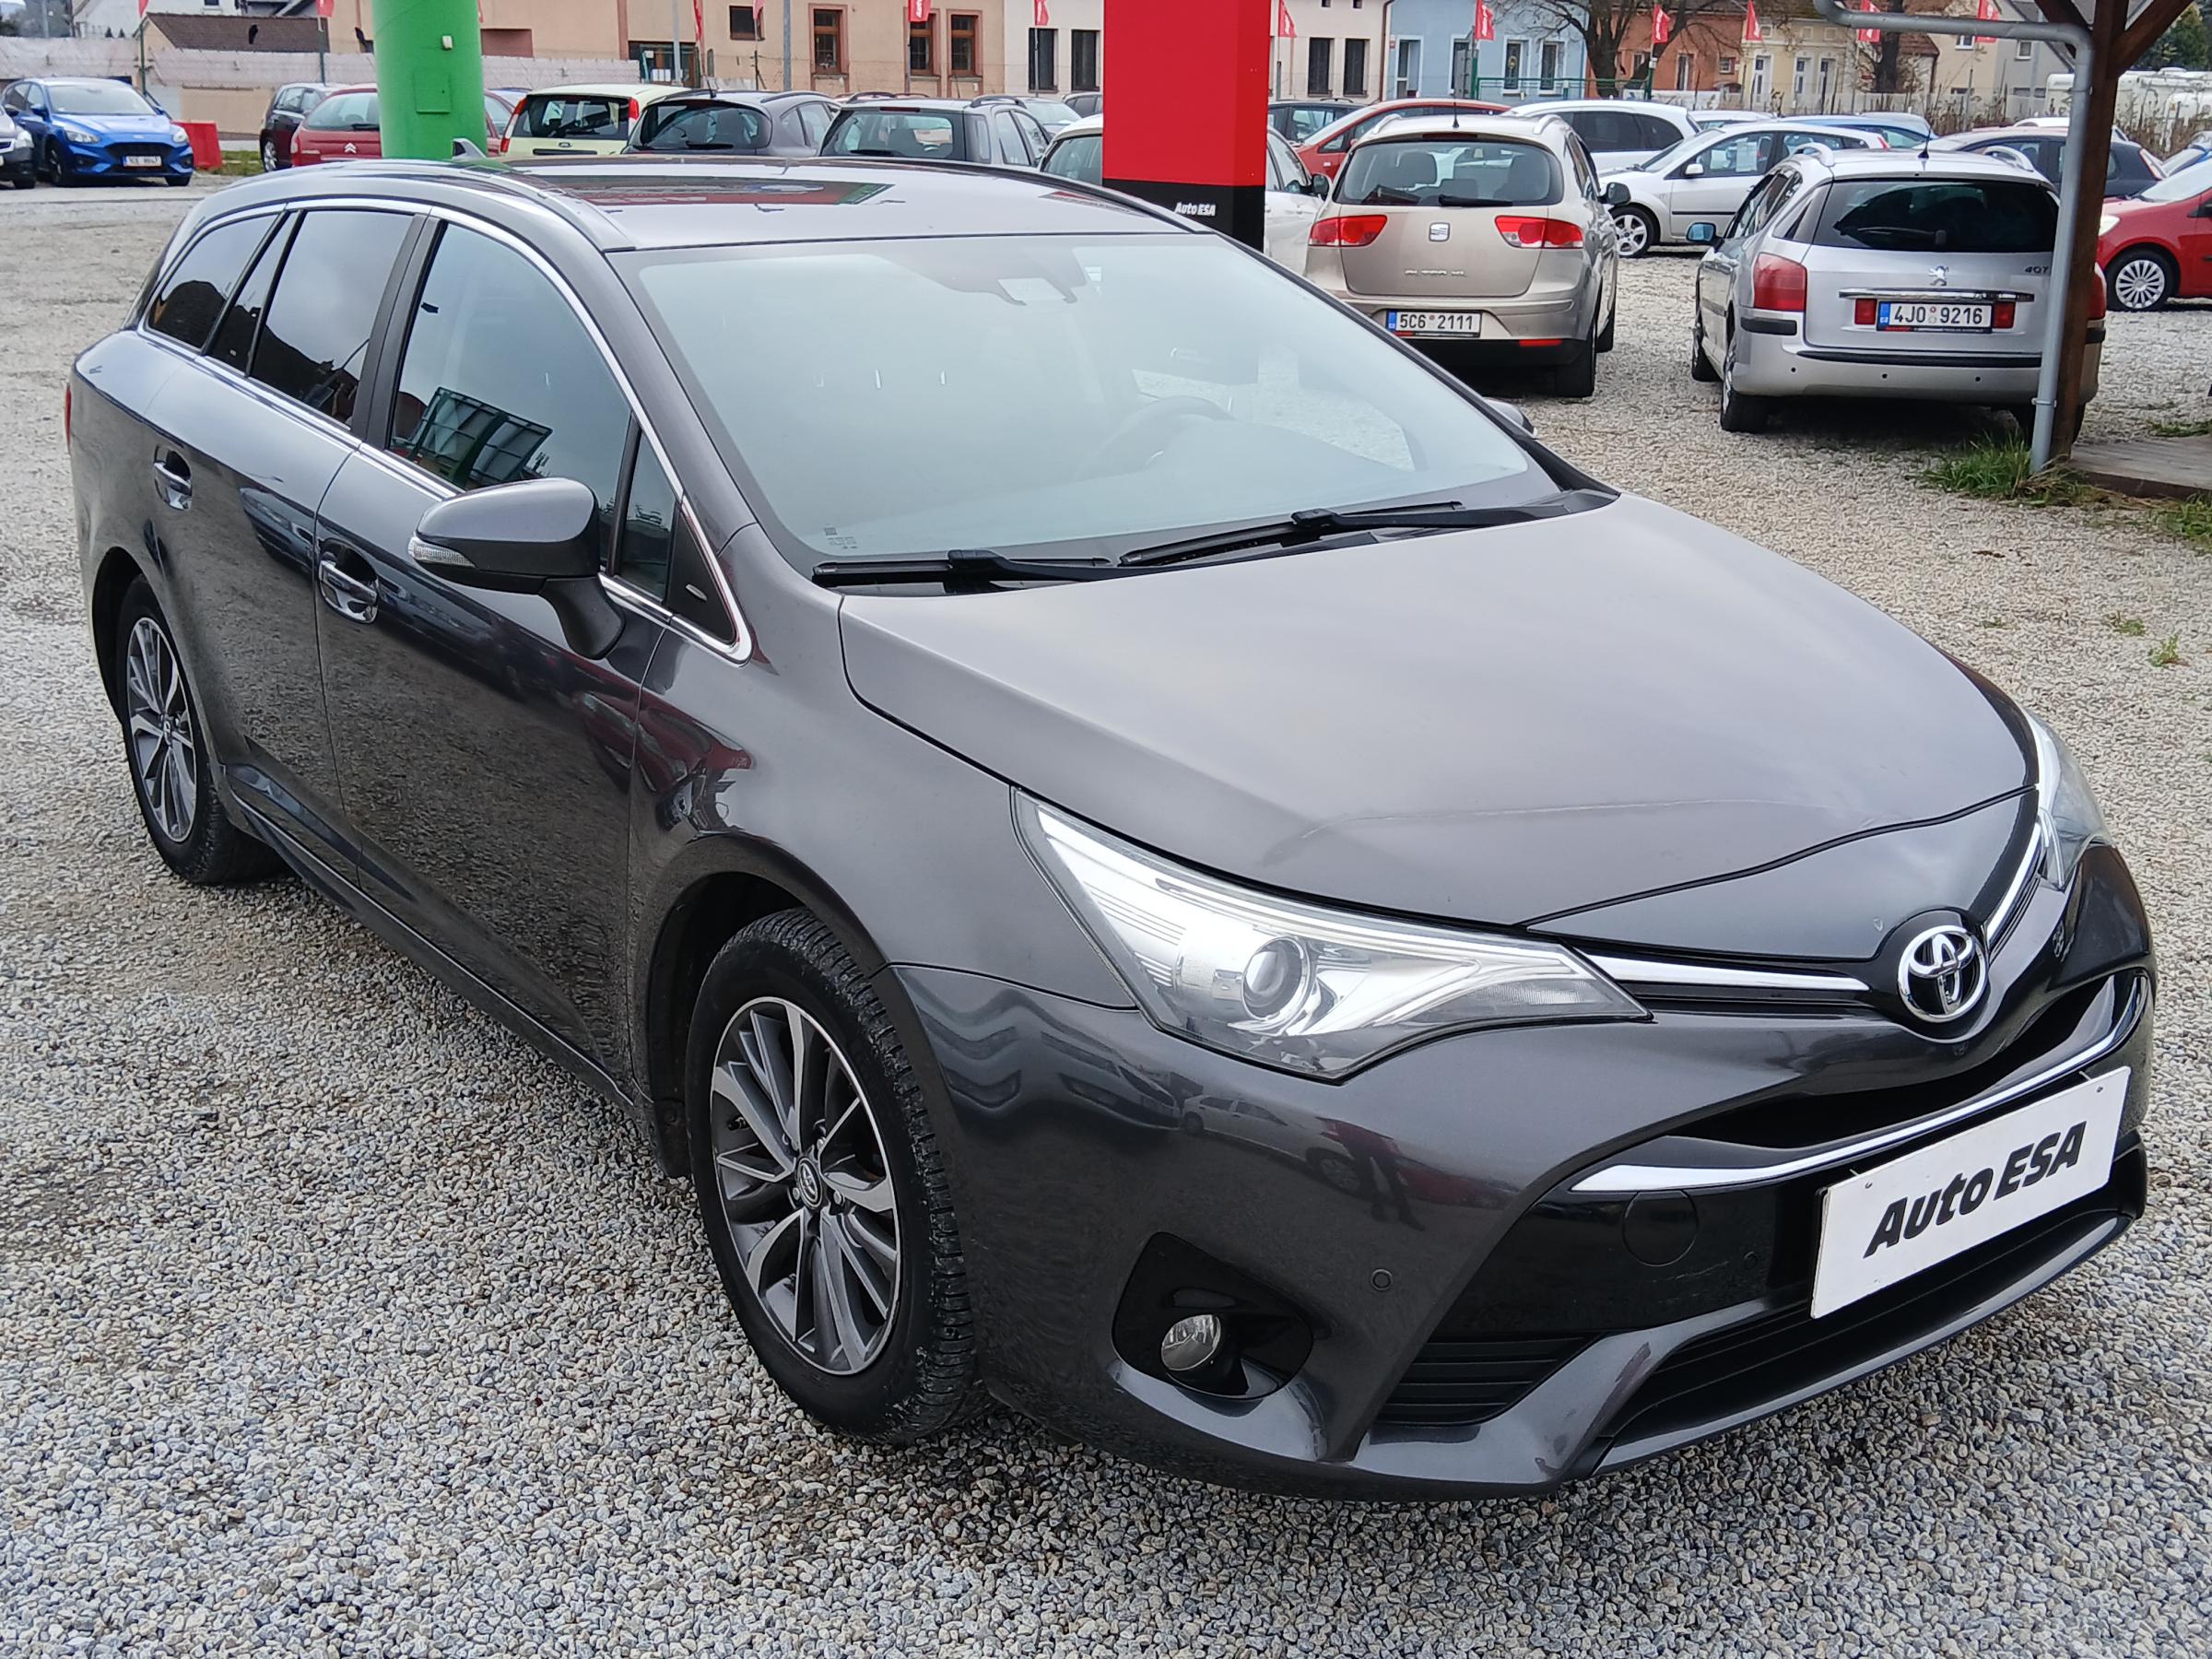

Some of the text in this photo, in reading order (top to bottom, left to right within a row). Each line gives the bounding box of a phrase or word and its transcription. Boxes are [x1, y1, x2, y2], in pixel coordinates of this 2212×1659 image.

[1174, 201, 1217, 217] Auto ESA
[2024, 265, 2049, 274] 407
[1400, 313, 1473, 330] 5C6 2111
[1894, 305, 1983, 324] 4J0 9216
[1862, 1120, 2088, 1259] Auto ESA
